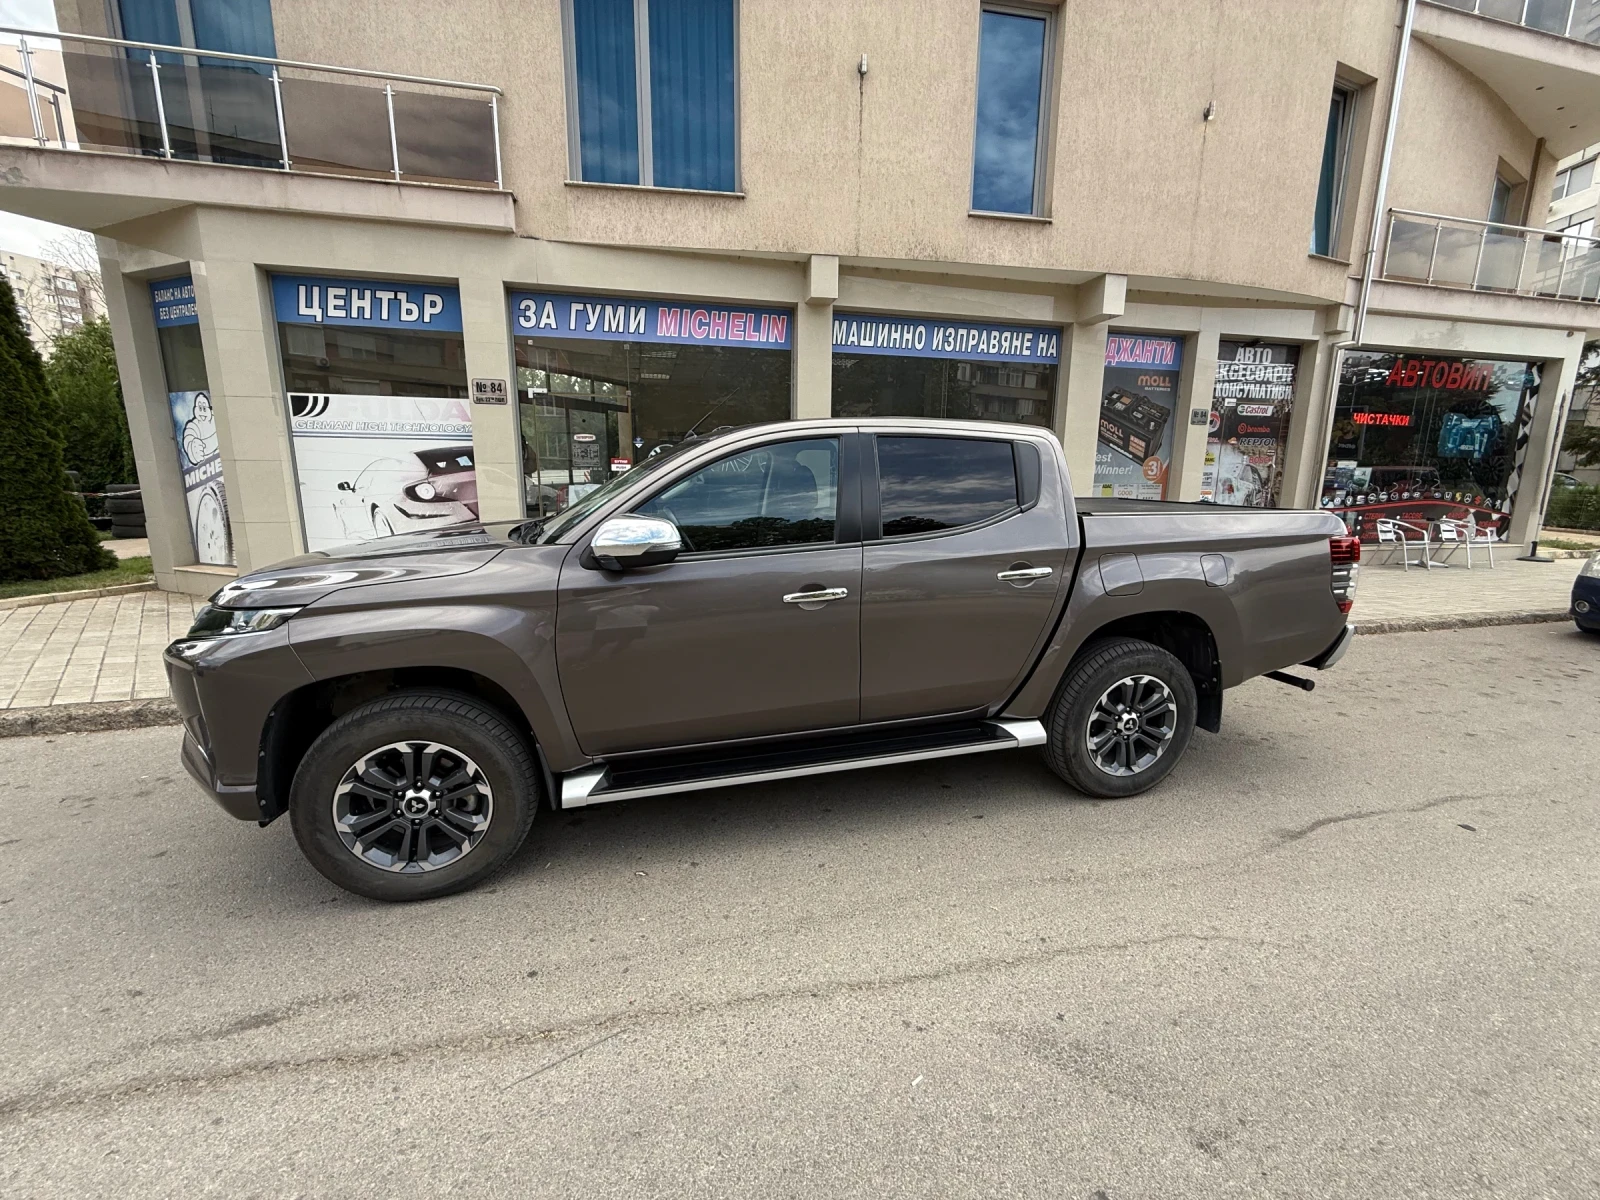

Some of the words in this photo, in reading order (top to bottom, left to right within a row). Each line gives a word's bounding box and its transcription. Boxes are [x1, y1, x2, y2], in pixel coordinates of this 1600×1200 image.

[155, 289, 174, 302] БАЛАНС
[174, 287, 181, 299] НА
[297, 283, 445, 323] ЦЕНТЪР
[160, 307, 169, 319] БЕЗ
[518, 298, 558, 330] ЗА
[568, 302, 647, 335] ГУМИ
[656, 306, 788, 343] MICHELIN
[832, 319, 927, 352] МАШИННО
[931, 325, 1034, 357] ИЗПРАВЯНЕ
[1037, 332, 1058, 358] НА
[1105, 337, 1176, 366] ДЖАНТИ
[1235, 347, 1273, 364] АВТО
[1386, 359, 1495, 390] АВТОВИП
[490, 382, 502, 394] 84
[1215, 382, 1293, 400] КОНСУМАТИВИ
[1245, 405, 1269, 415] Castrol
[1353, 412, 1410, 426] ЧИСТАЧКИ
[295, 420, 353, 430] GERMAN
[355, 421, 390, 431] HIGH
[390, 422, 473, 433] TECHNOLOGY
[1247, 425, 1270, 433] brembo
[1239, 437, 1276, 446] REPSOL
[1094, 465, 1133, 475] Winner!
